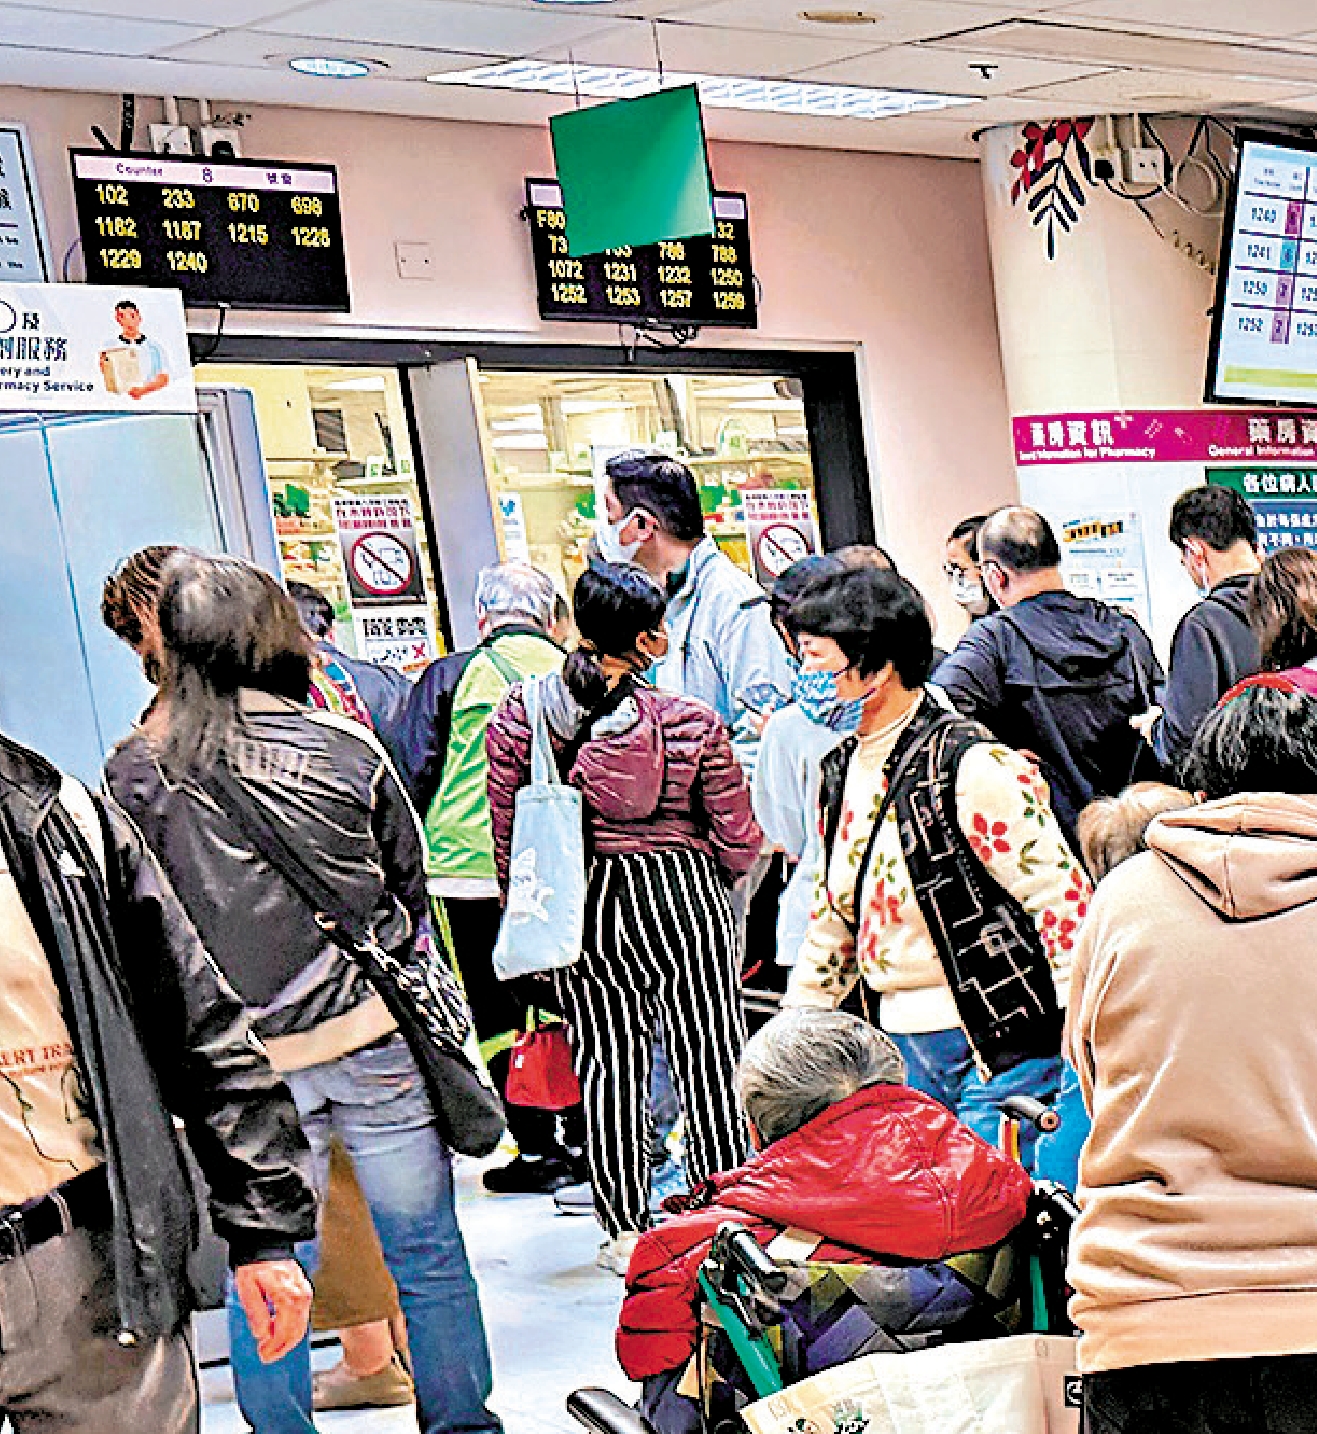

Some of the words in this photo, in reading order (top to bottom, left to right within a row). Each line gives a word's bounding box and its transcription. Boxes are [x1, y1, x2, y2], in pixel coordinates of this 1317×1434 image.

[202, 167, 213, 183] 8
[95, 184, 129, 206] 102
[162, 188, 196, 209] 233
[227, 223, 269, 245] 1215
[167, 251, 208, 273] 1240
[548, 260, 584, 280] 1072
[604, 262, 637, 282] 1231
[26, 365, 51, 377] and
[44, 381, 94, 392] Service
[1208, 445, 1254, 457] General
